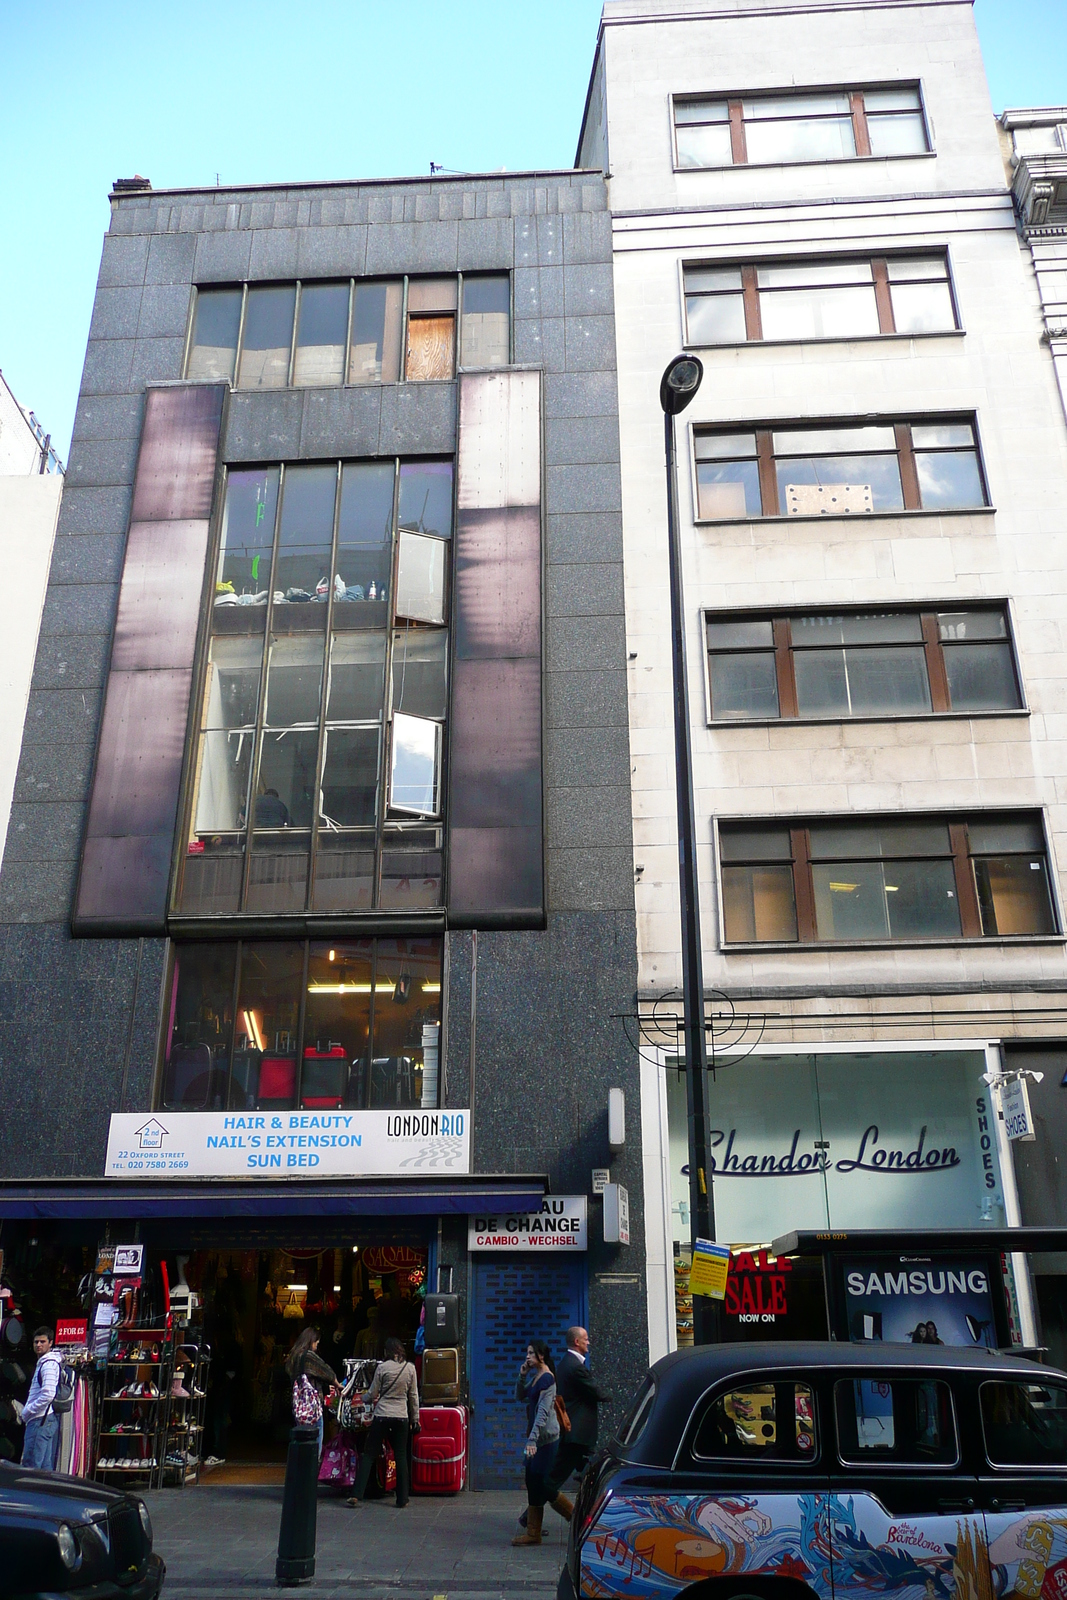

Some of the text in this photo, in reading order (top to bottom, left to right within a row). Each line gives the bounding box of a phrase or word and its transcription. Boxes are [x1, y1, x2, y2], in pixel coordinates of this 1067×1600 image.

[223, 1116, 353, 1129] HAIR & BEAUTY
[1005, 1112, 1027, 1137] SHOES
[206, 1134, 362, 1148] NAIL'S EXTENSION
[975, 1097, 996, 1189] SHOES
[835, 1125, 961, 1173] London
[128, 1161, 143, 1169] 020
[145, 1161, 166, 1169] 7580
[247, 1154, 320, 1167] SUN BED
[475, 1218, 580, 1232] DE CHANGE
[477, 1236, 519, 1245] CAMBIO
[528, 1236, 578, 1245] WECHSEL
[728, 1250, 793, 1271] ALE
[847, 1270, 988, 1296] SAMSUNG
[725, 1275, 787, 1315] SALE
[739, 1314, 776, 1323] NOW ON
[58, 1327, 63, 1335] 2
[63, 1327, 76, 1335] FOR
[885, 1526, 943, 1554] Barcelona
